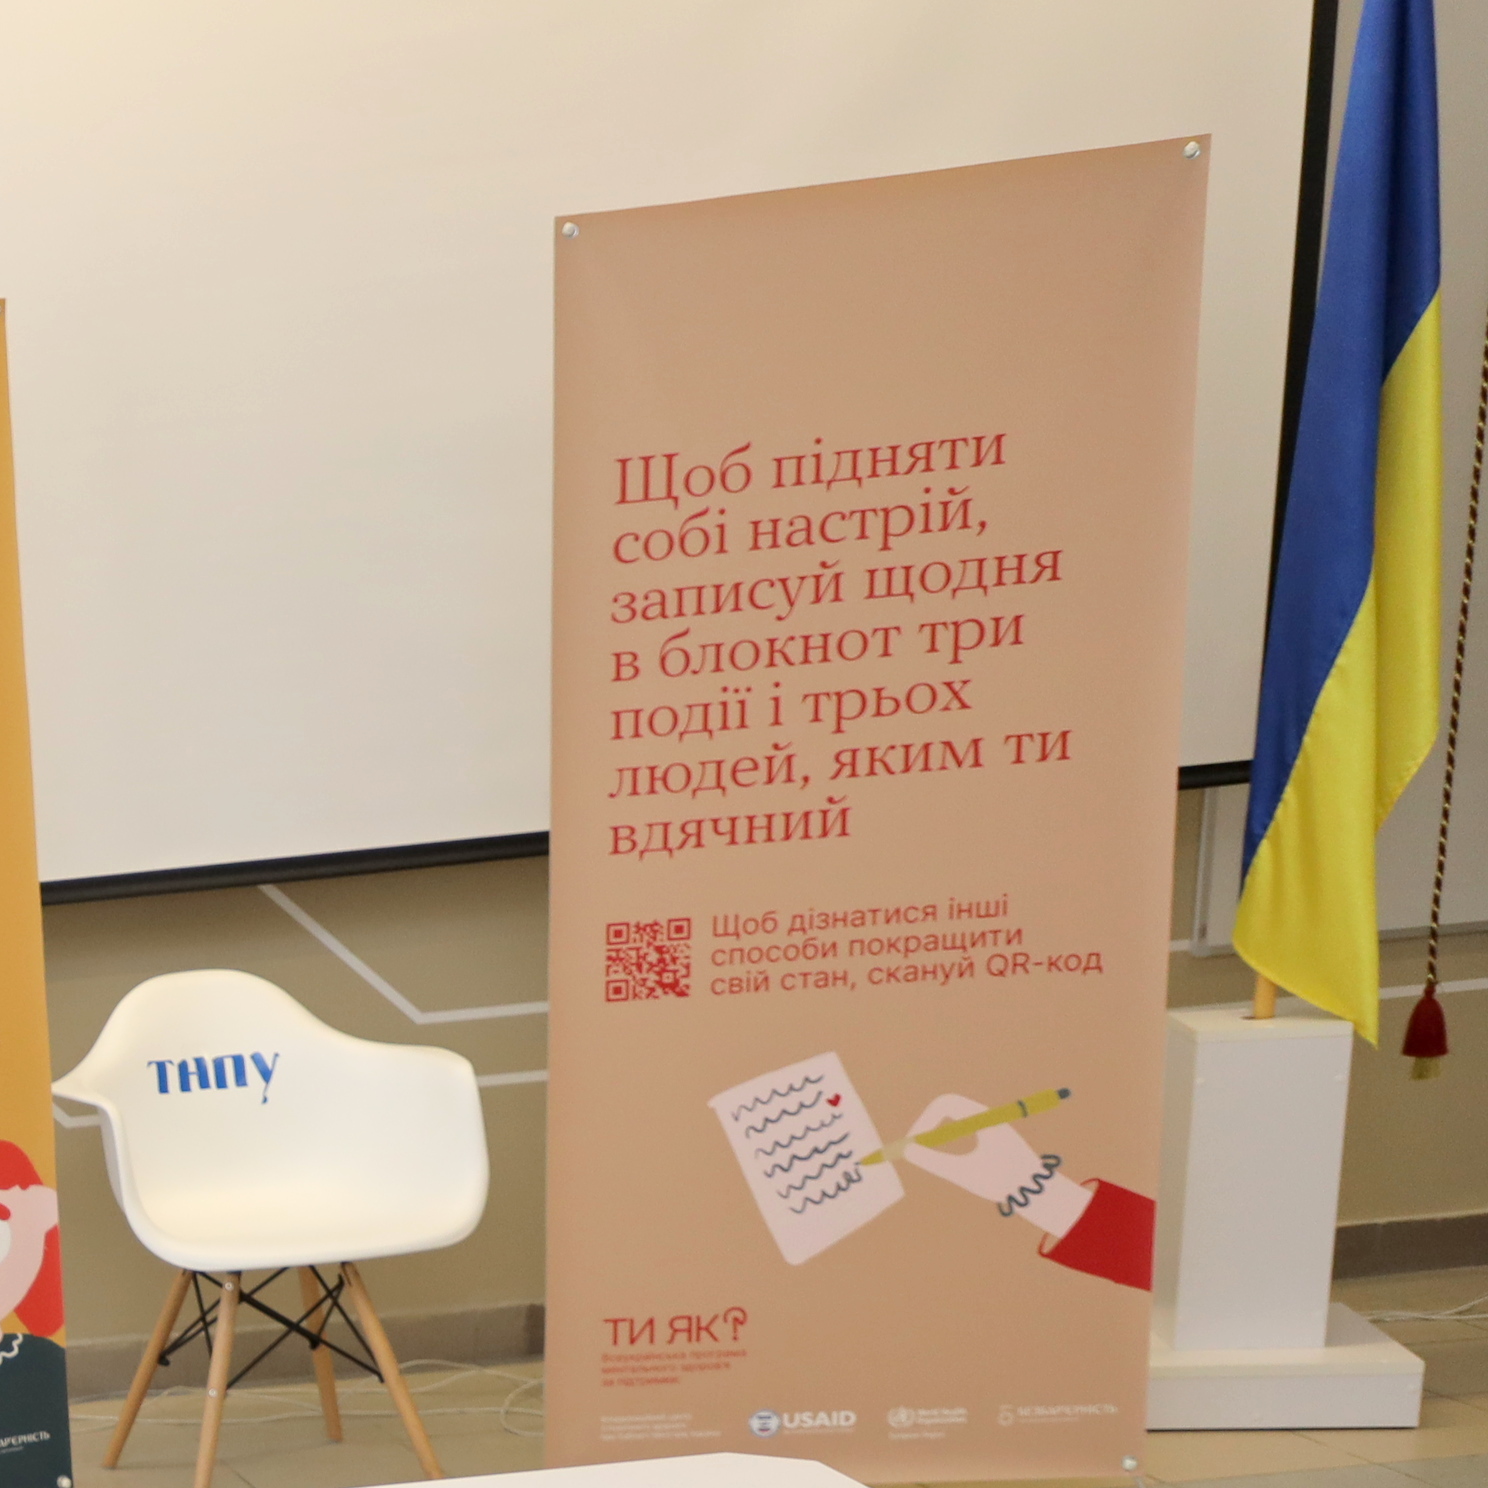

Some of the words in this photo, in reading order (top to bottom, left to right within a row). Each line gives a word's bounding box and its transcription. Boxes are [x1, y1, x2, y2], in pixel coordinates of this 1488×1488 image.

[615, 441, 752, 510] Щоб
[772, 433, 1007, 491] підняти
[613, 507, 728, 564] собі
[749, 486, 988, 552] настрій,
[611, 560, 844, 624] записуй
[864, 550, 1063, 603] щодня
[611, 651, 641, 682] в
[659, 626, 902, 677] блокнот
[918, 614, 1024, 665] три
[611, 687, 752, 742] події
[769, 682, 783, 728] і
[802, 679, 972, 734] трьох
[608, 742, 810, 799] людей,
[829, 737, 984, 780] яким
[1004, 730, 1072, 764] ти
[609, 795, 852, 861] вдячний
[711, 937, 838, 967] способи
[849, 928, 1023, 958] покращити
[712, 910, 778, 940] Щоб
[787, 904, 937, 936] дізнатися
[949, 893, 1008, 920] інші
[710, 970, 770, 996] свій
[780, 970, 856, 991] стан,
[867, 956, 975, 986] скануй
[986, 952, 1103, 978] QR-код
[147, 1052, 279, 1104] ТНПУ
[604, 1317, 655, 1346] ТИ
[666, 1306, 748, 1344] ЯК?
[782, 1410, 857, 1428] USAID
